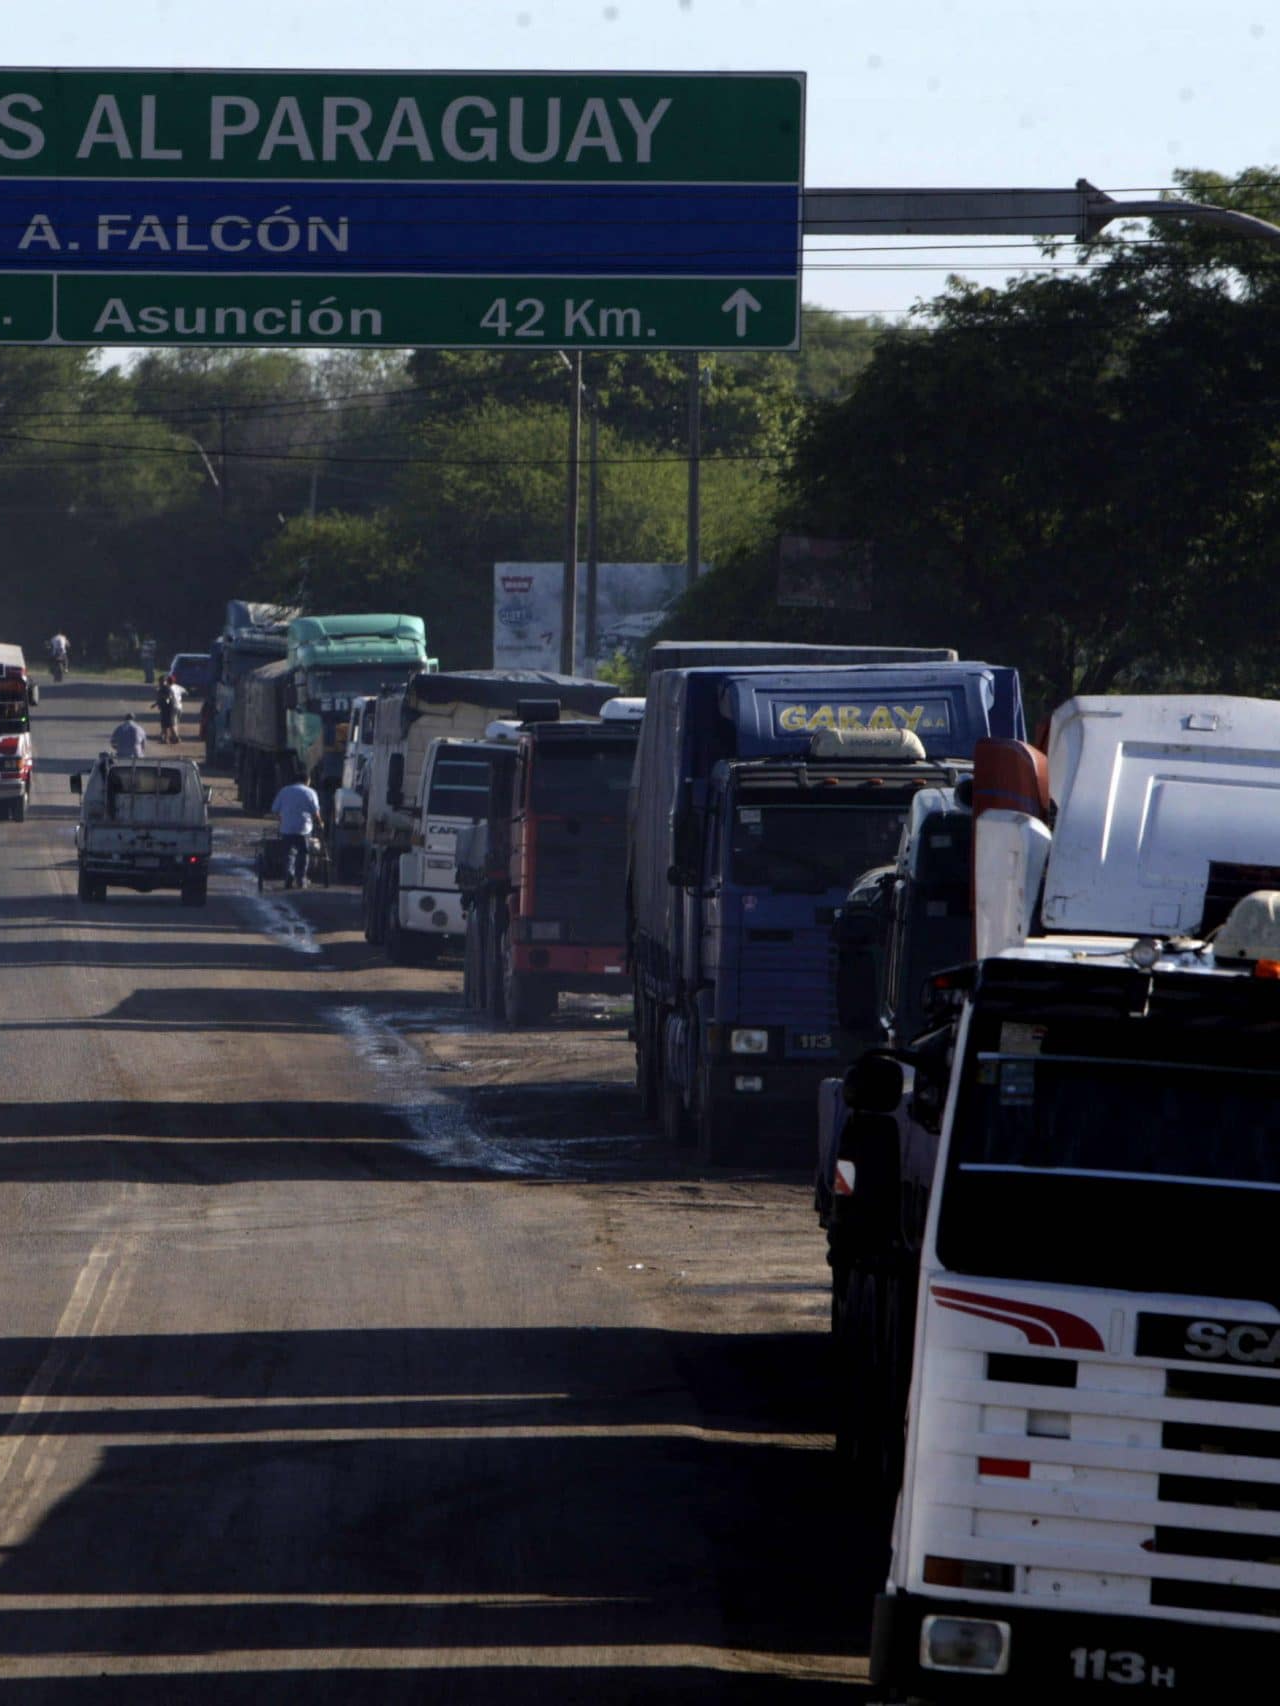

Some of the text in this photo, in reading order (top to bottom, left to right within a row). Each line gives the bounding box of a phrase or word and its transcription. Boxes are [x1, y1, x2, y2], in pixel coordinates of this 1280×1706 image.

[76, 93, 184, 160] AL
[209, 94, 673, 164] PARAGUAY
[18, 214, 80, 249] A.
[97, 206, 350, 252] FALCÓN
[93, 297, 384, 337] Asunción
[479, 298, 658, 338] 42 Km.
[779, 704, 925, 733] GARAY
